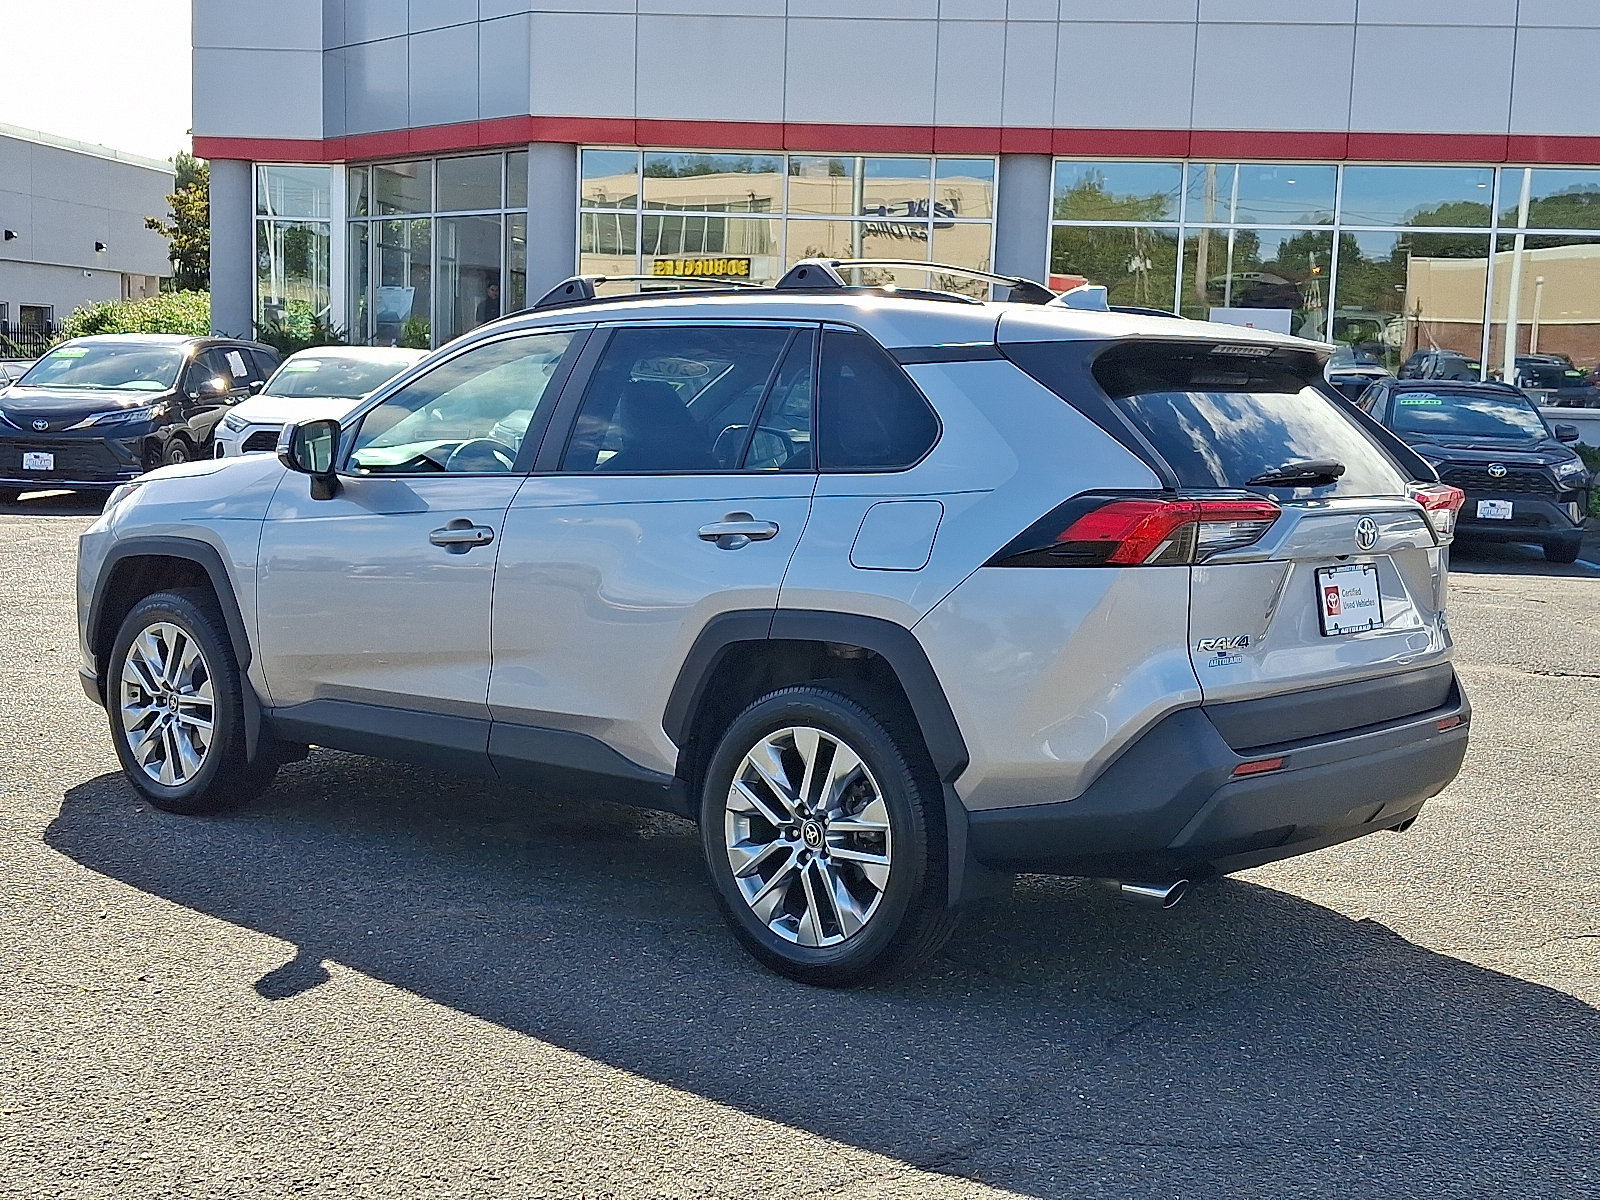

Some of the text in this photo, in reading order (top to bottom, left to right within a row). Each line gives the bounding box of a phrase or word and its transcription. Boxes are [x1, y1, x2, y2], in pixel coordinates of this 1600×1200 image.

[1341, 587, 1362, 598] Certified
[1342, 598, 1376, 609] Used Vehicles
[1340, 624, 1372, 634] AUTOLAND
[1196, 634, 1250, 652] RAV4
[1208, 655, 1243, 667] AUTOLAND
